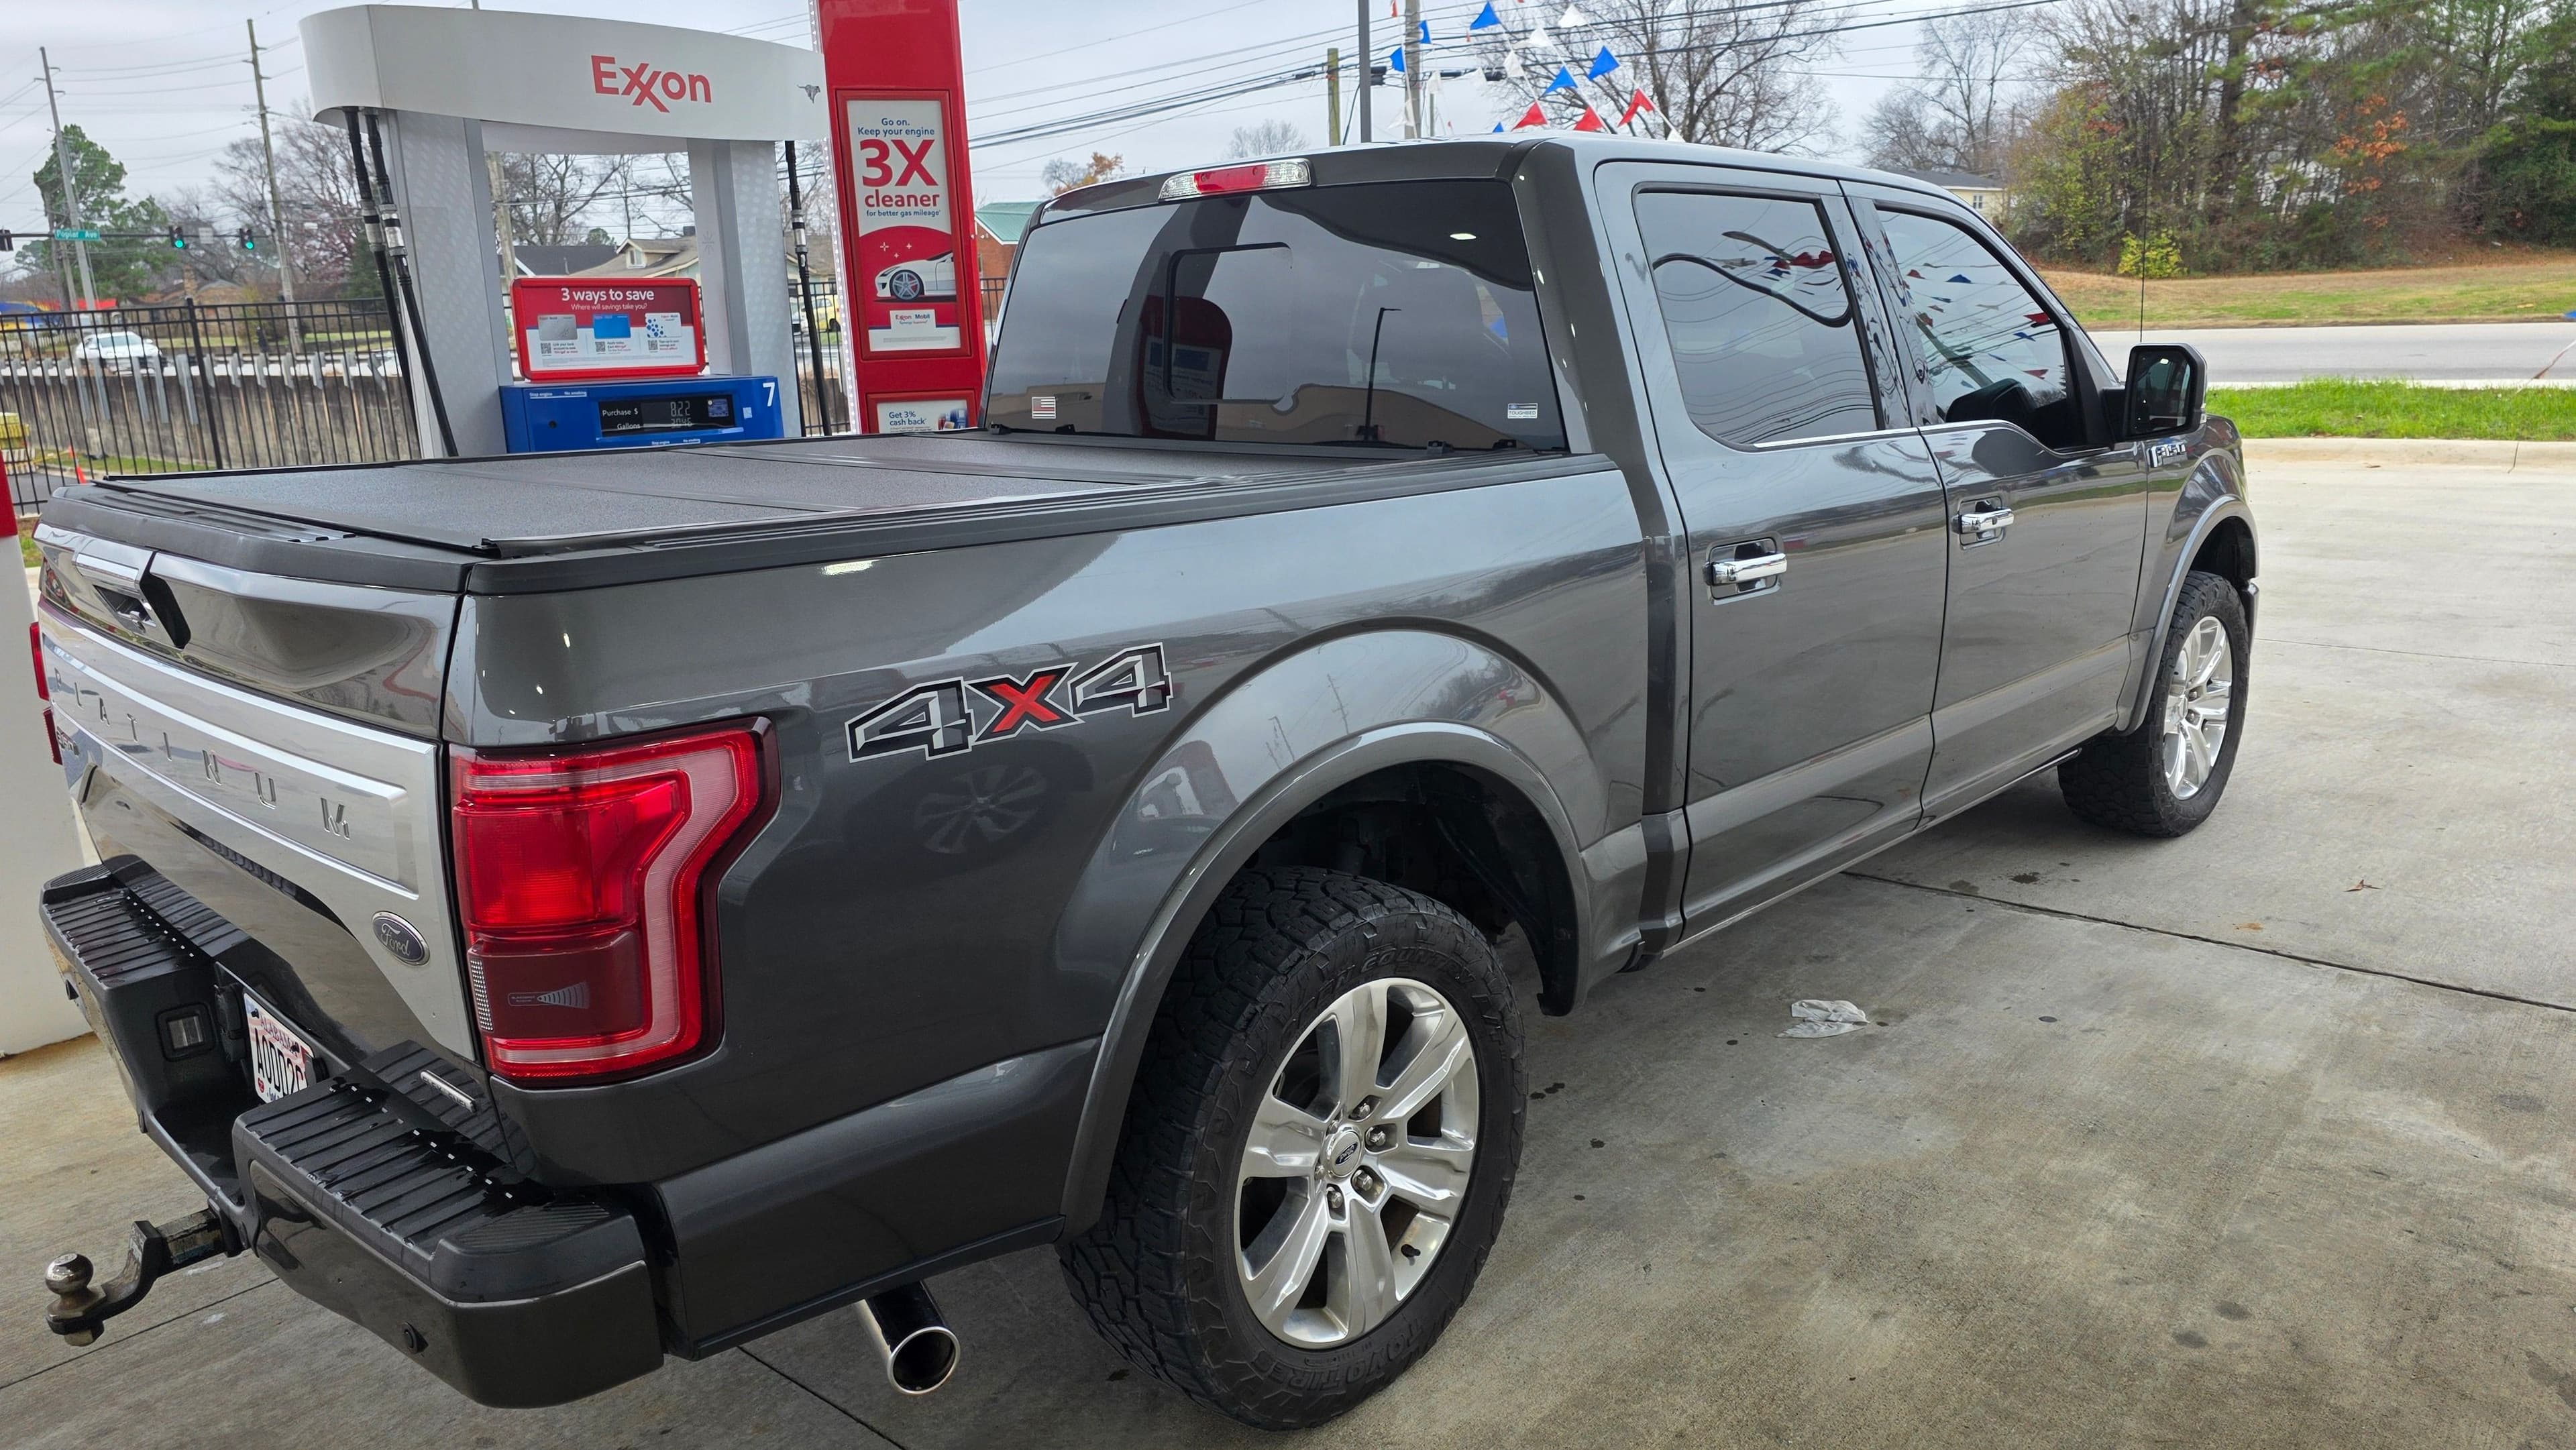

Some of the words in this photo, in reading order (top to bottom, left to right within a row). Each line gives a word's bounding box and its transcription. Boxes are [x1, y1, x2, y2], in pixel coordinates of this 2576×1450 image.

[590, 55, 712, 113] Exxon
[881, 117, 894, 126] Go
[857, 127, 880, 137] Keep
[883, 129, 903, 137] your
[905, 127, 934, 137] engine
[859, 138, 939, 188] 3X
[864, 188, 940, 208] cleaner
[561, 288, 570, 301] 3
[572, 290, 607, 304] ways
[609, 288, 623, 300] to
[626, 290, 655, 300] save
[602, 303, 622, 311] savings
[635, 302, 647, 311] you?
[762, 382, 775, 407] 7
[602, 408, 631, 416] Purchase
[633, 407, 639, 415] $
[904, 410, 916, 419] 3%
[616, 422, 641, 430] Gallons
[52, 667, 351, 840] PLATINUM
[380, 922, 411, 956] Ford
[1346, 1317, 1423, 1386] TOYO
